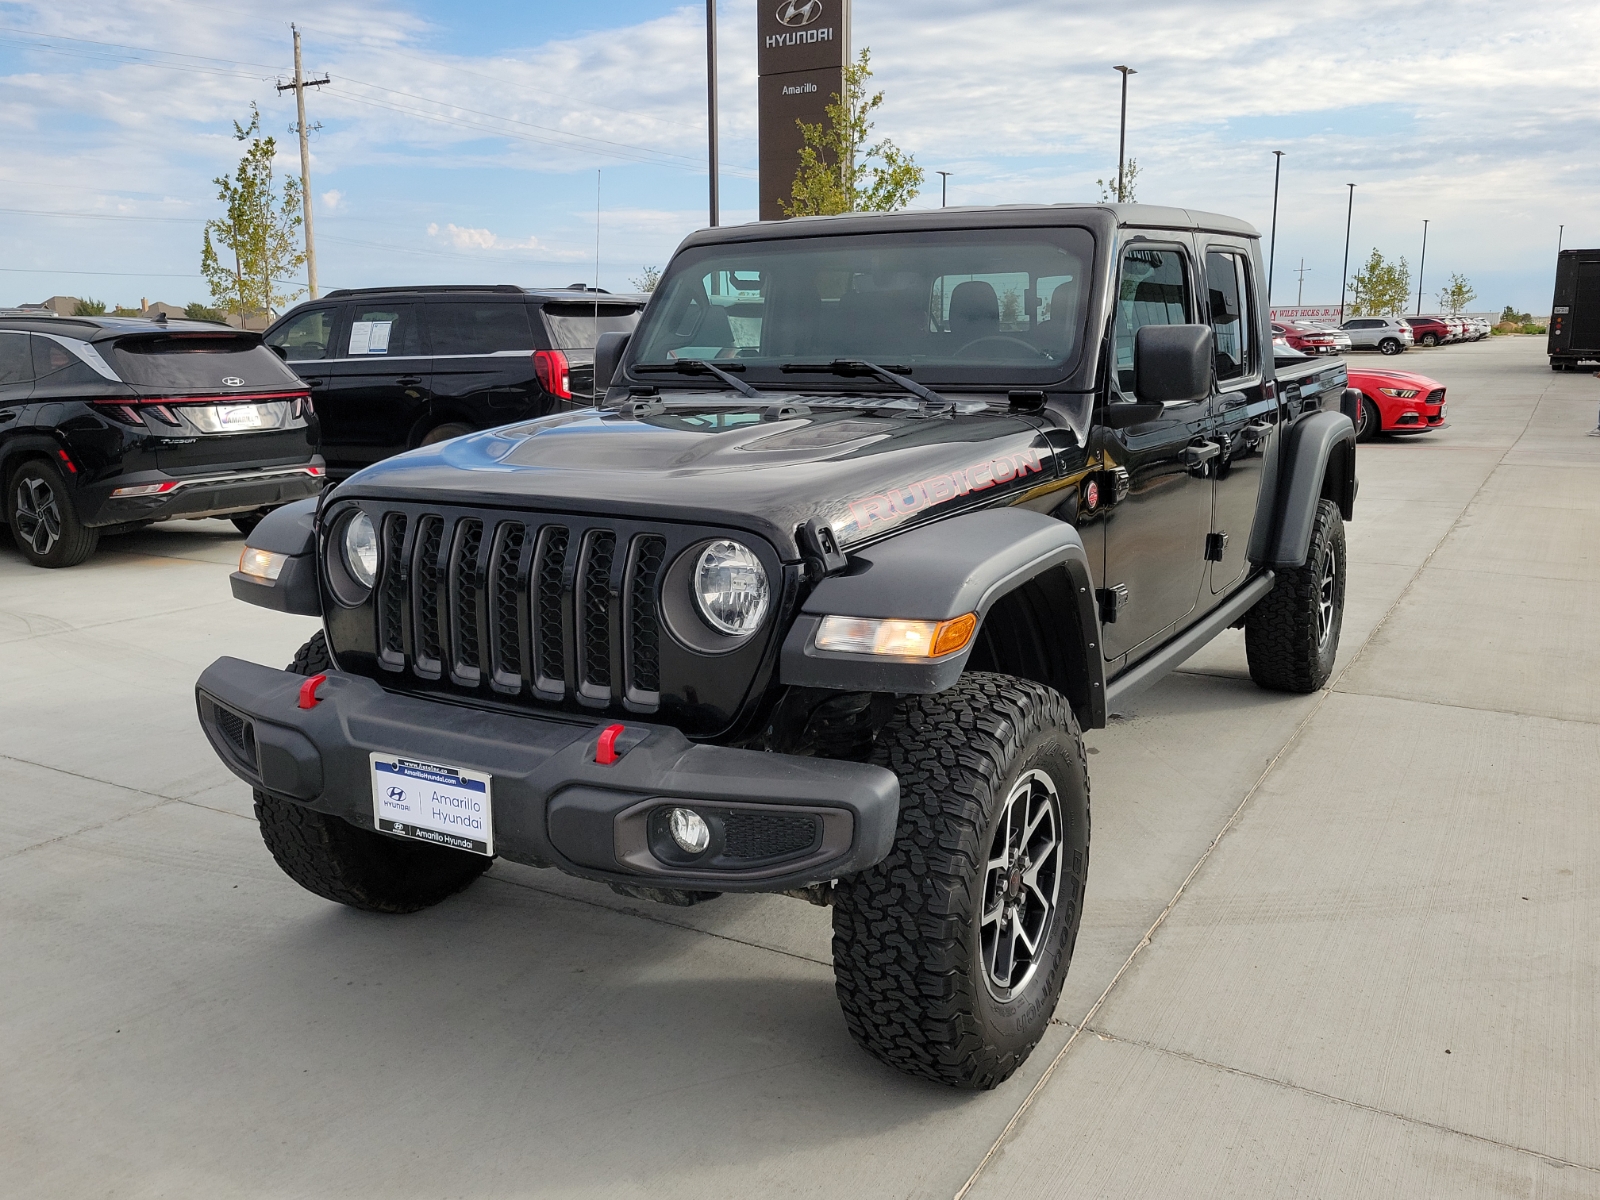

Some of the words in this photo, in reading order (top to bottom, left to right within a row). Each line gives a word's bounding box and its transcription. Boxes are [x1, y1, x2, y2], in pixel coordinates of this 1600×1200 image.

[766, 27, 833, 48] HYUNDAI
[782, 83, 817, 95] Amarillo
[1300, 309, 1320, 317] HICKS
[849, 450, 1043, 530] RUBICON
[404, 768, 457, 785] AmarilloHyundai.com
[383, 800, 411, 811] HYUNDAI
[431, 790, 481, 813] Amarillo
[432, 807, 483, 830] Hyundai
[415, 829, 444, 842] Amarillo
[444, 835, 473, 849] Hyundai
